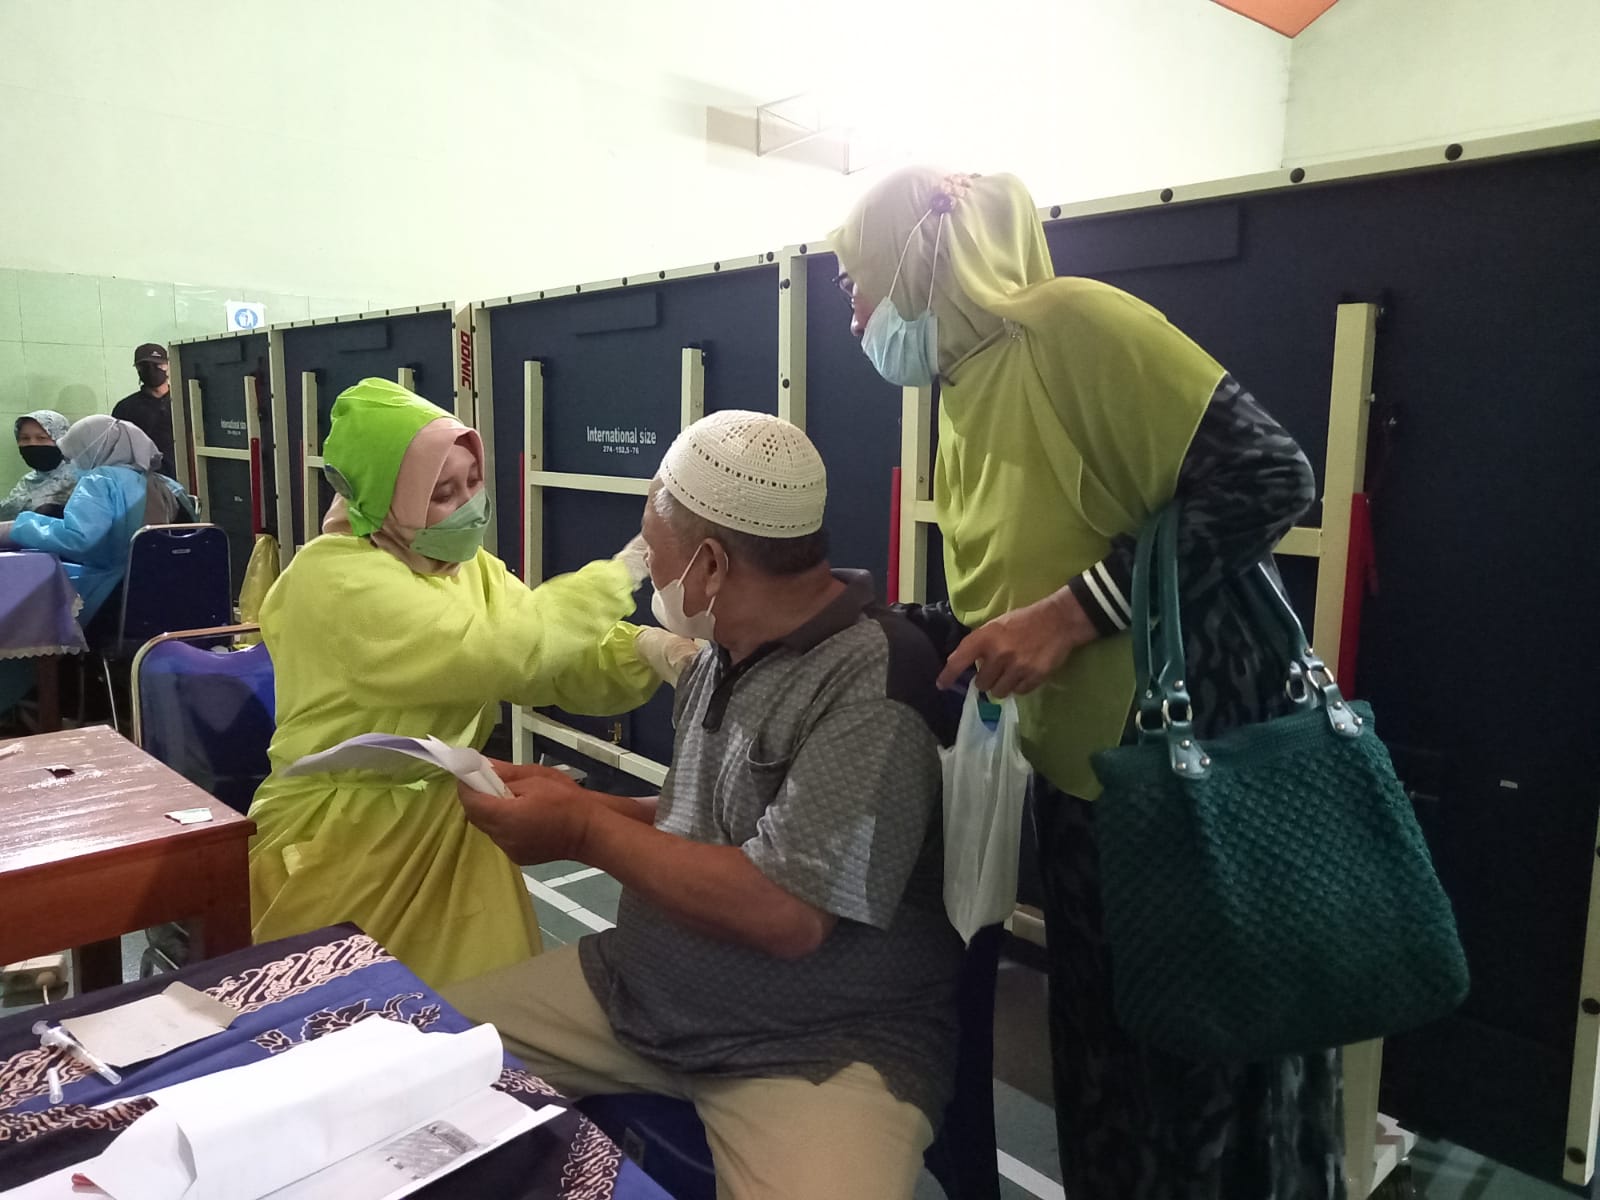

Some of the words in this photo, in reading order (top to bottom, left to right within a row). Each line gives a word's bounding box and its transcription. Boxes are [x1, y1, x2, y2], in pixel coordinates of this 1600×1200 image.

[461, 330, 471, 390] DONIC
[587, 426, 637, 443] International
[640, 427, 656, 444] size
